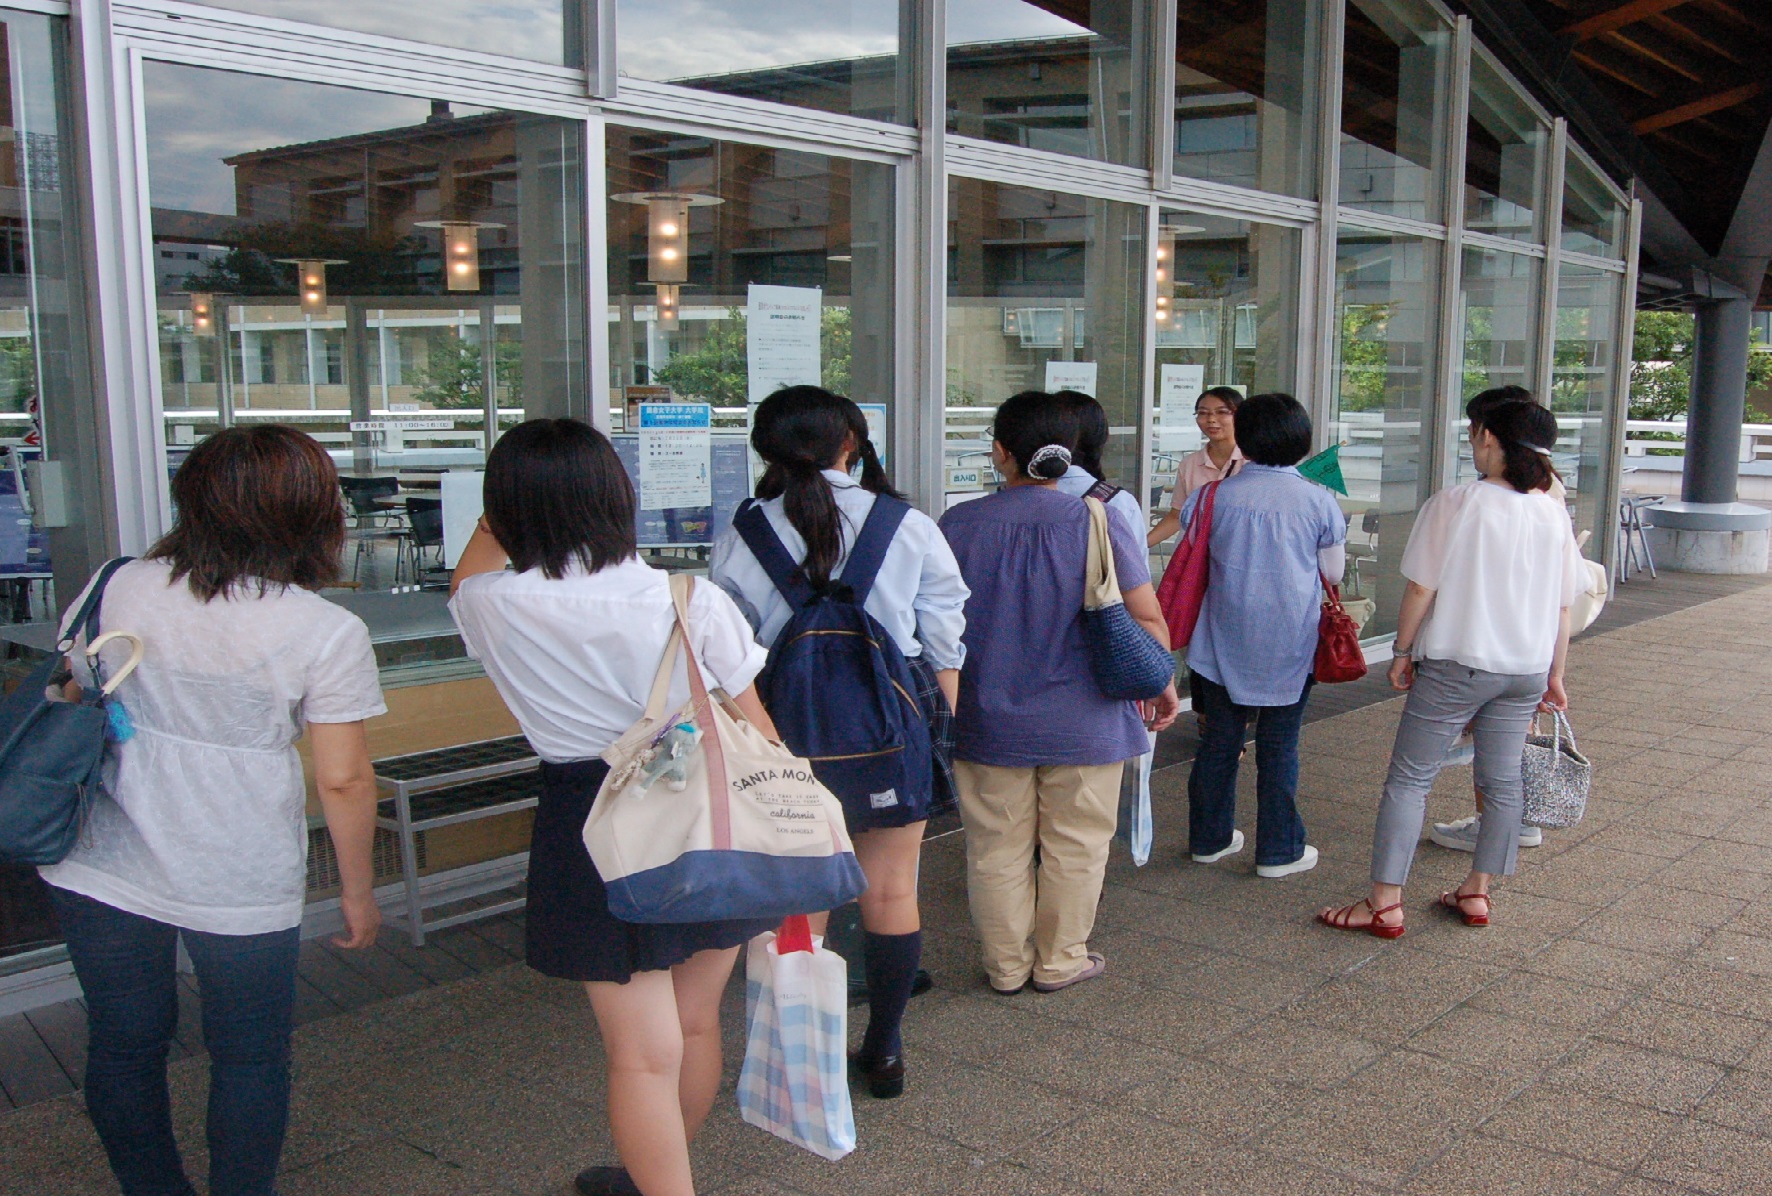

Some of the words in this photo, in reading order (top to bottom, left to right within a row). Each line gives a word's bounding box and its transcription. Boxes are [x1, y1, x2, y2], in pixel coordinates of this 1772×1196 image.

[733, 770, 778, 791] SANTA
[770, 809, 815, 819] california
[776, 826, 789, 834] LOS
